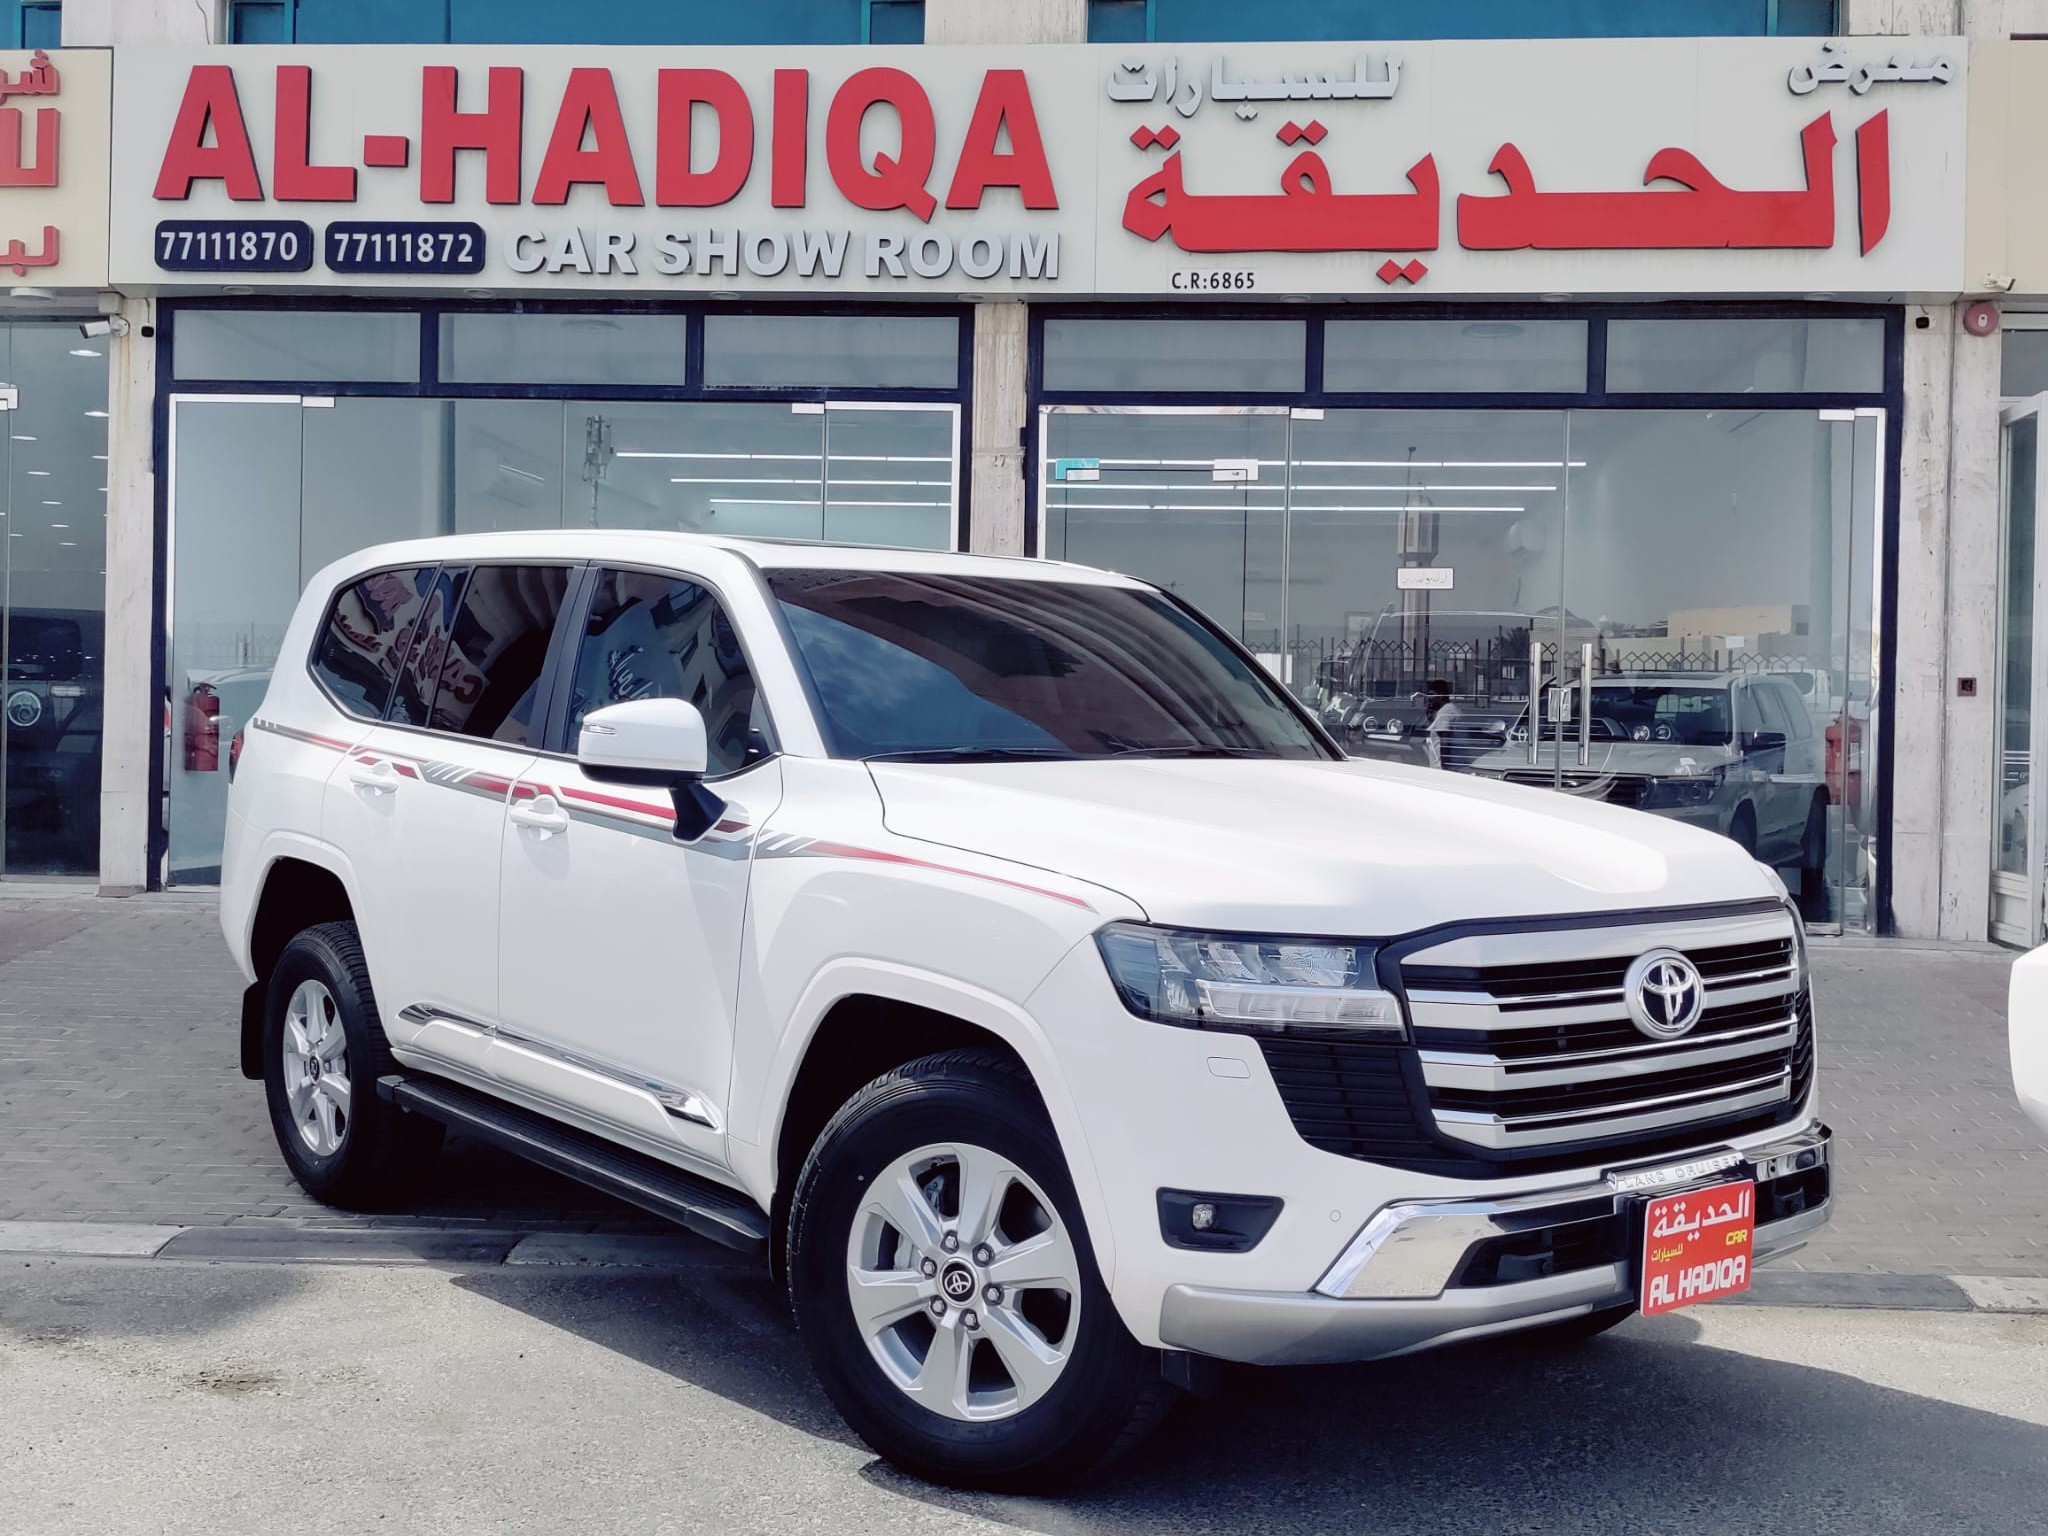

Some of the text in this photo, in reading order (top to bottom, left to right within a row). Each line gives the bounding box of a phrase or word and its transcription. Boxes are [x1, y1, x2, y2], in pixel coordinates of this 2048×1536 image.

[1107, 52, 1404, 120] للسيارات
[1787, 41, 1954, 96] معرض
[152, 64, 1060, 223] AL-HADIQA
[1122, 107, 1891, 285] الحديقة
[159, 229, 299, 262] 77111870
[333, 231, 473, 264] 77111872
[502, 226, 1060, 280] CAR SHOW ROOM
[1171, 271, 1256, 291] C.R:6865
[1652, 1189, 1750, 1242] الحديقة
[1725, 1229, 1748, 1246] CAR
[1651, 1243, 1684, 1263] للسيارات
[1648, 1255, 1747, 1308] AL HADIQA
